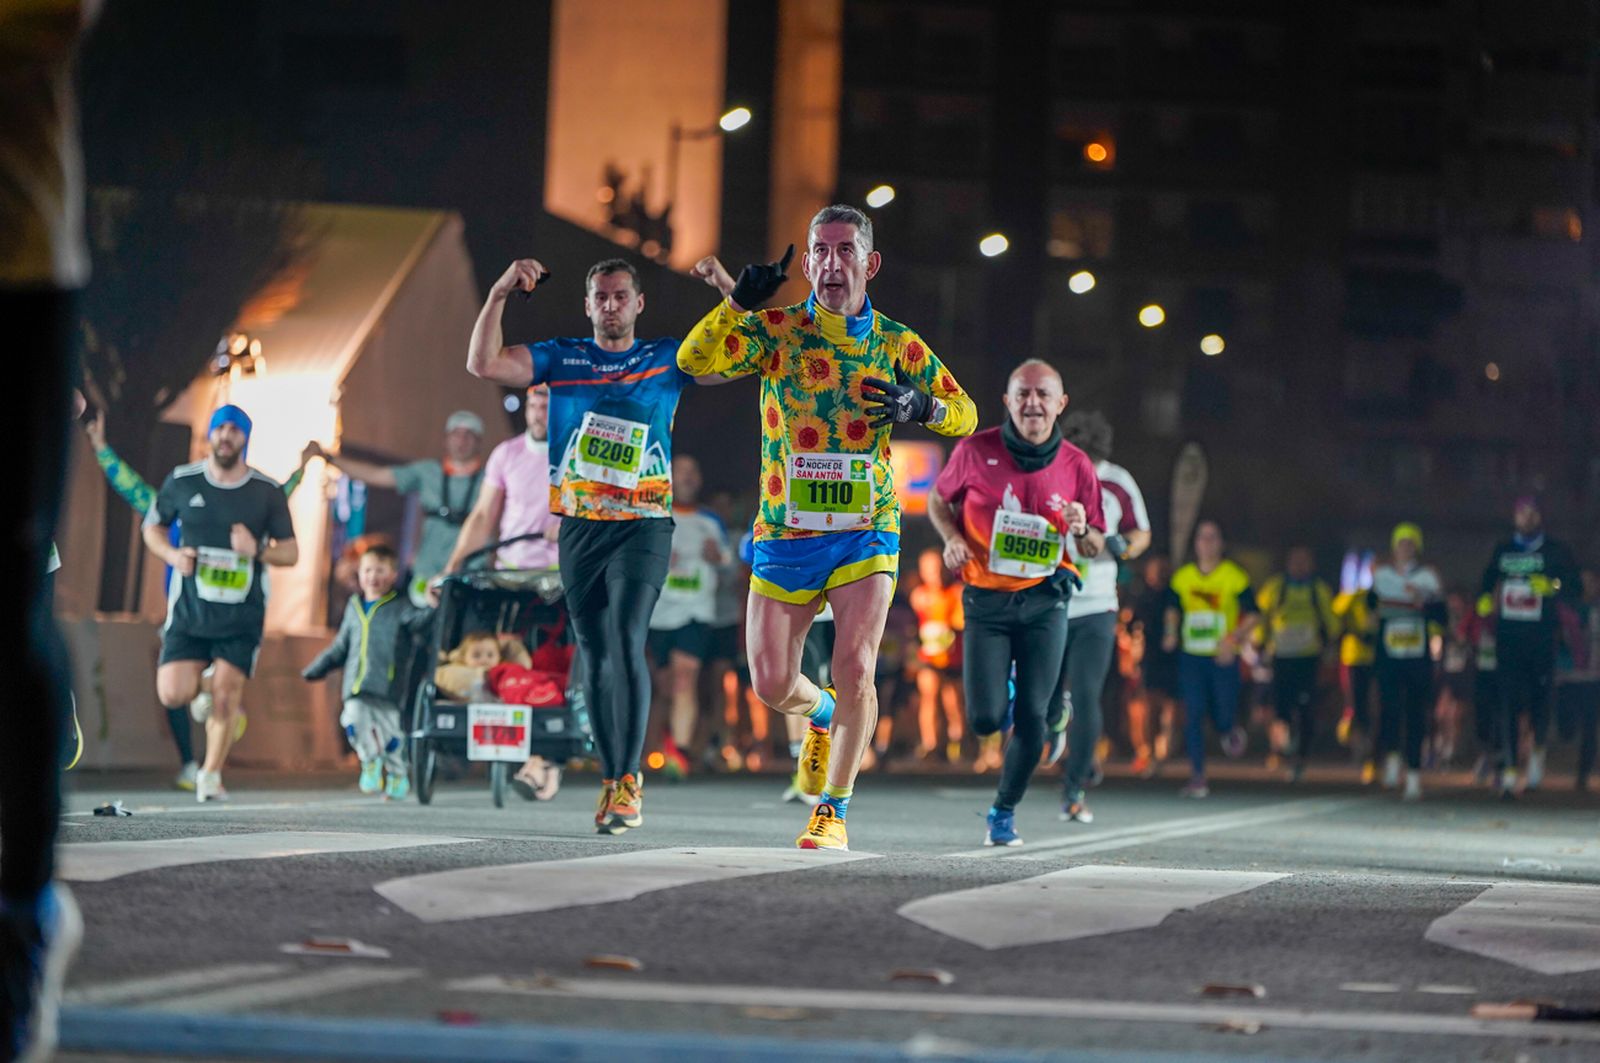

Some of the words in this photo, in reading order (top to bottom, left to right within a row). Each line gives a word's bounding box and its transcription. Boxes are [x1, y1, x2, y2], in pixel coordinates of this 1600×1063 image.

[587, 437, 634, 465] 6209
[796, 470, 813, 479] SAN
[806, 461, 831, 470] NOCHE
[833, 462, 843, 470] DE
[807, 481, 853, 505] 1110
[1003, 535, 1051, 559] 9596
